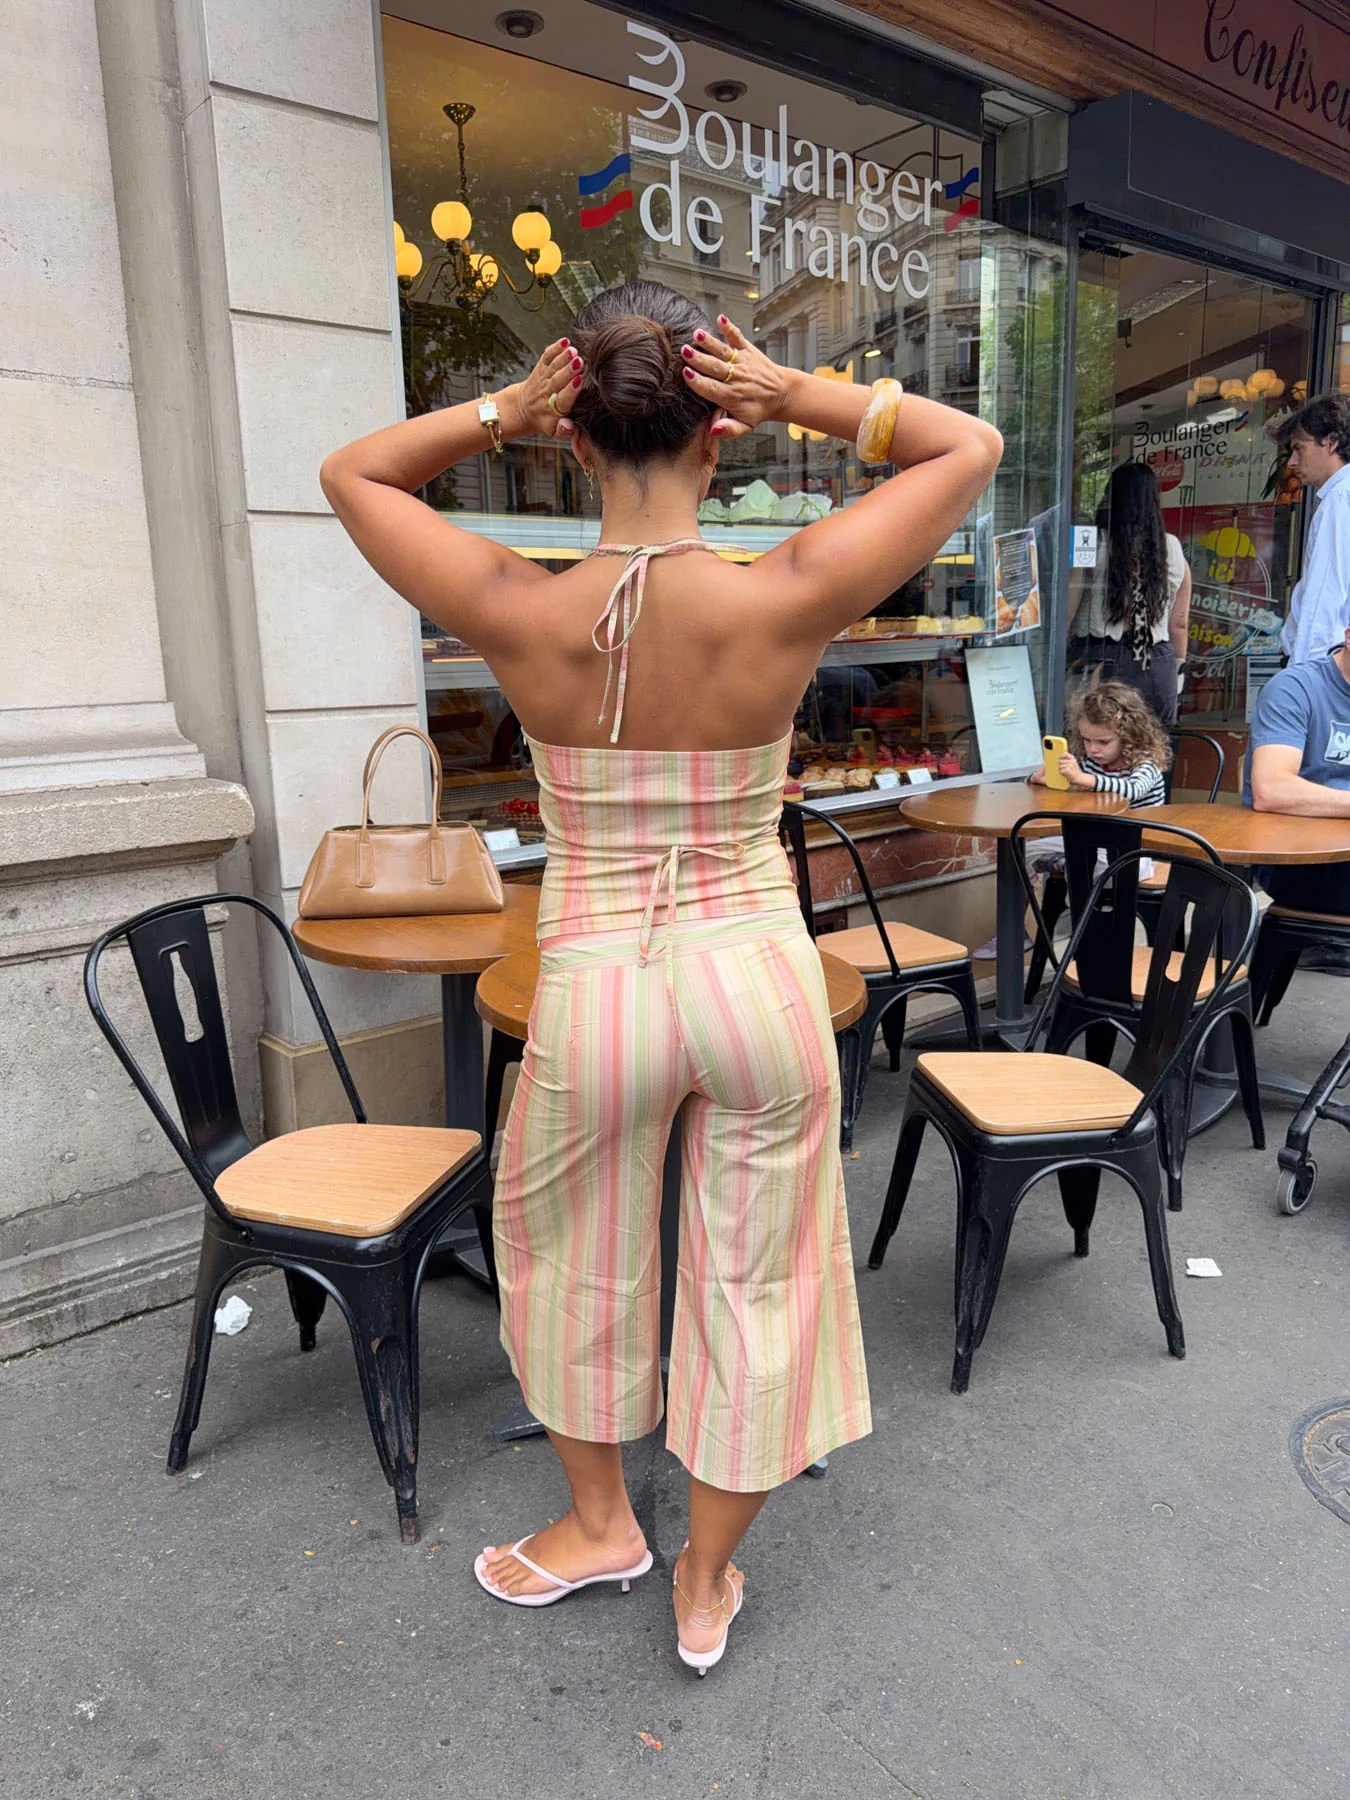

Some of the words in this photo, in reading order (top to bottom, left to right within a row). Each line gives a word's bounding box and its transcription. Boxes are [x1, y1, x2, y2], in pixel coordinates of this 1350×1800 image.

[627, 21, 943, 233] Boulanger
[639, 159, 724, 254] de
[751, 193, 931, 299] France
[1134, 419, 1234, 448] Boulanger
[1135, 447, 1157, 465] de
[1164, 440, 1228, 462] France
[1188, 620, 1233, 648] aison
